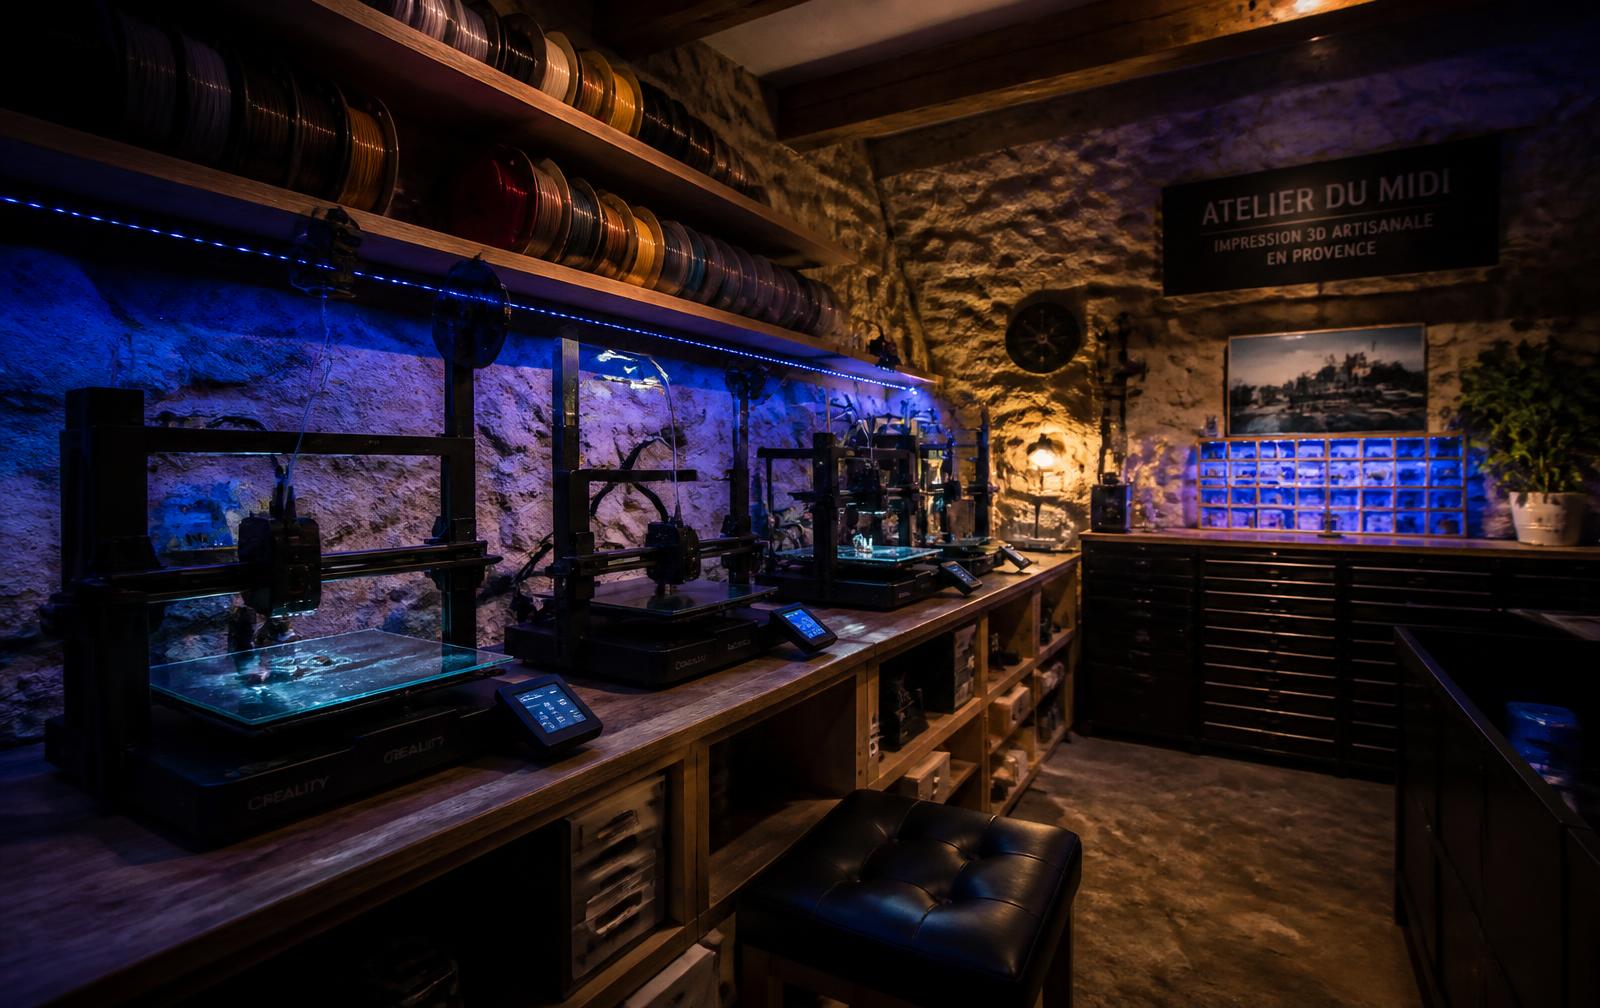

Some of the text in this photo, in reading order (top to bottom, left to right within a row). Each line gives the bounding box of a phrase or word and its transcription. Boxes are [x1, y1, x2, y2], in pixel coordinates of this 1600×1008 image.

[1201, 167, 1452, 226] ATELIER DU MIDI
[1213, 212, 1434, 254] IMPRESSION 3D ARTISANALE
[1266, 240, 1377, 266] EN PROVENCE
